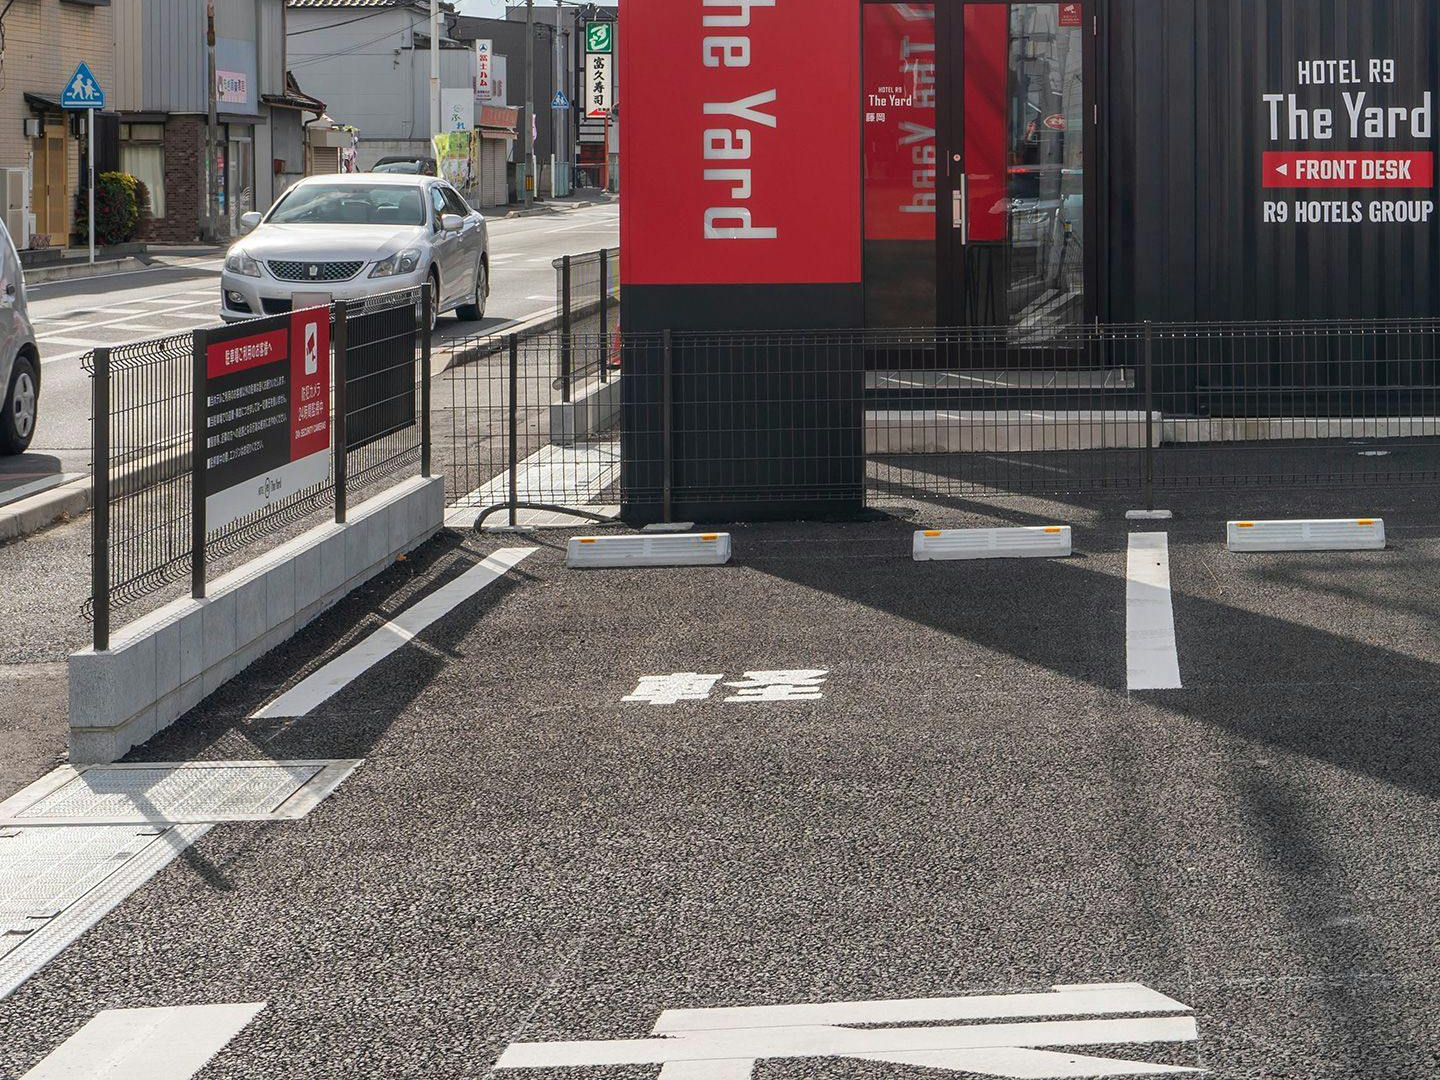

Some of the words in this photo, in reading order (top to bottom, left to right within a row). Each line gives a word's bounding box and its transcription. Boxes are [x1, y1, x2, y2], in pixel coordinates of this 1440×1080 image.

[593, 56, 605, 106] 富久寿司
[1298, 59, 1361, 85] HOTEL
[1369, 58, 1395, 83] R9
[868, 94, 887, 106] The
[889, 94, 912, 107] Yard
[1262, 93, 1333, 140] The
[1342, 91, 1432, 138] Yard
[703, 88, 777, 239] Yard
[1295, 159, 1357, 180] FRONT
[1361, 159, 1412, 180] DESK
[1263, 201, 1288, 223] R9
[1295, 201, 1363, 223] HOTELS
[1368, 200, 1434, 223] GROUP
